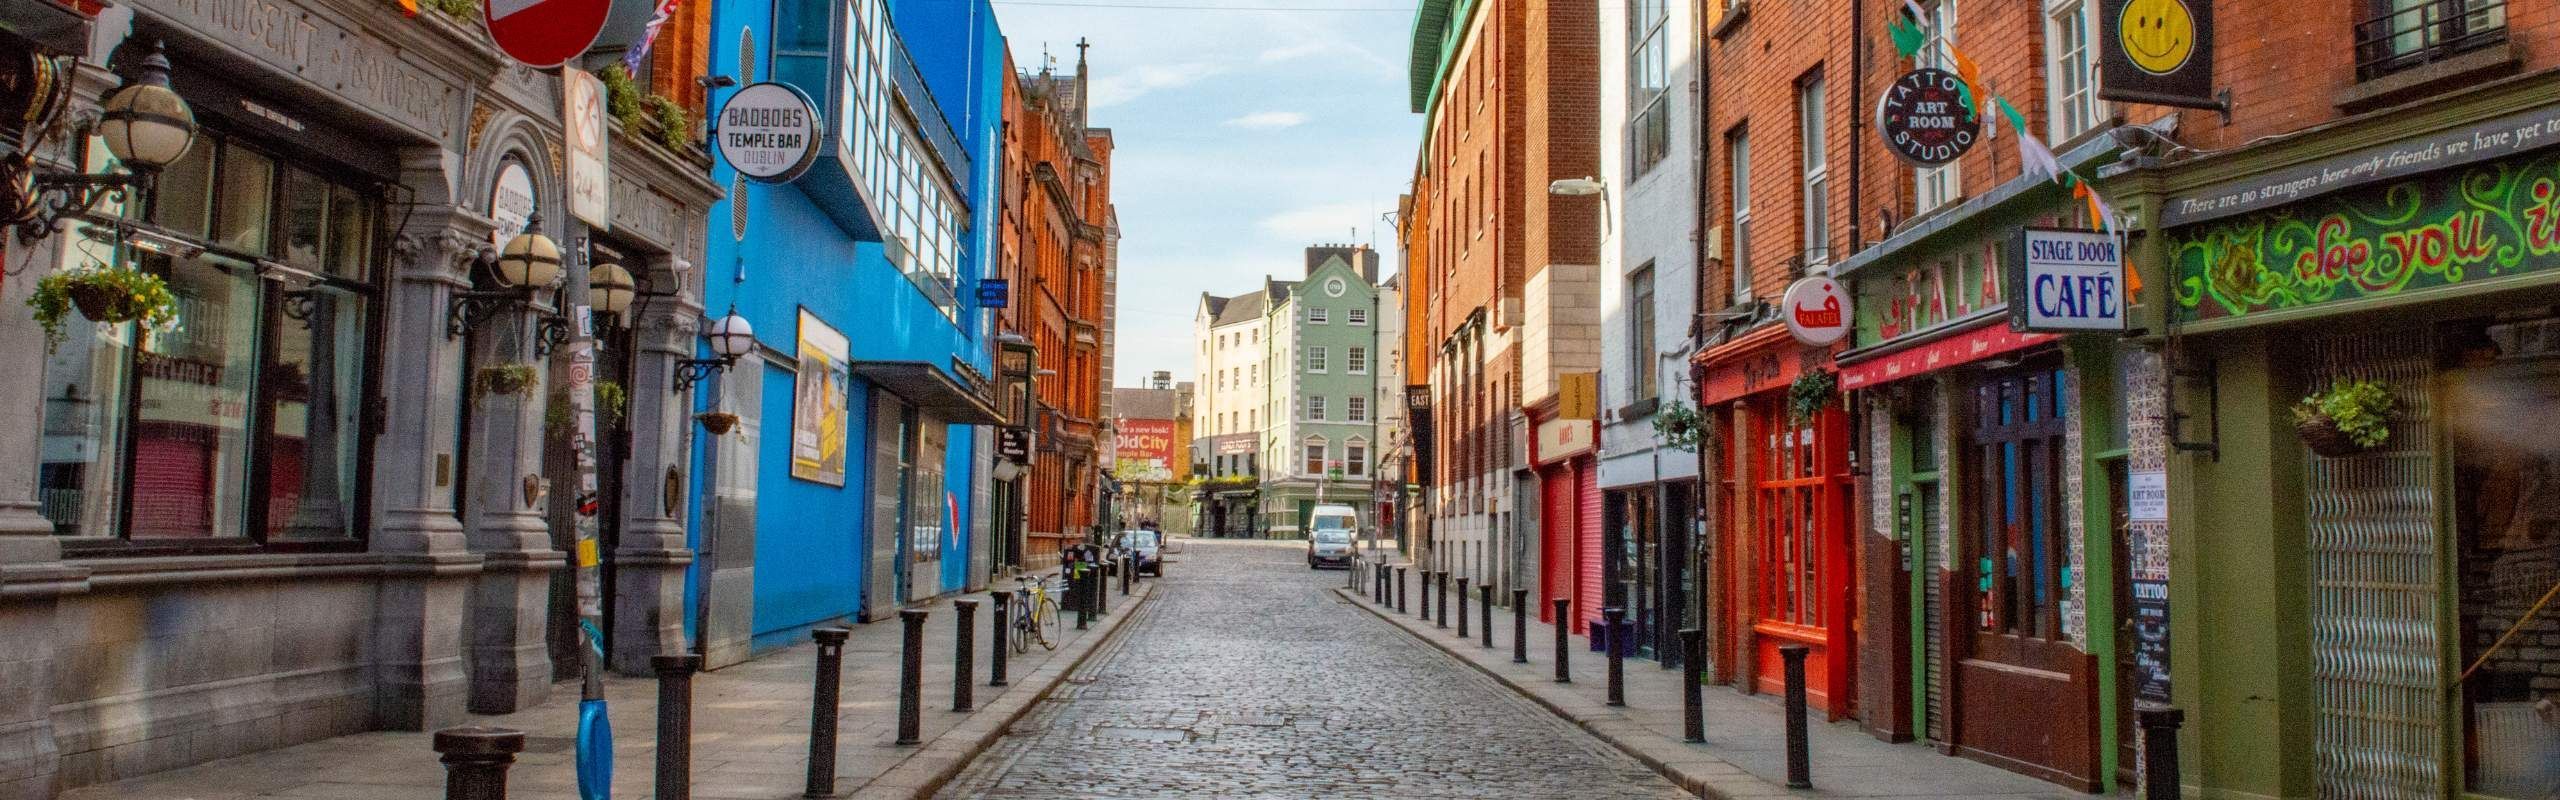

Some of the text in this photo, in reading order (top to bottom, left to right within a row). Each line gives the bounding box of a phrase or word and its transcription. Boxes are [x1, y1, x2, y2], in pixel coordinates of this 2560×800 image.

[212, 0, 320, 67] NUGENT
[729, 107, 802, 128] BADBOBS
[1915, 102, 1949, 114] ART
[1909, 116, 1955, 129] ROOM
[729, 133, 802, 148] TEMPLE BAR
[1895, 130, 1971, 160] STUDIO
[744, 150, 785, 164] DUBLIN
[2181, 198, 2215, 215] There
[2219, 194, 2238, 208] are
[2241, 190, 2257, 204] no
[2260, 174, 2317, 199] strangers
[2320, 168, 2349, 184] here
[2352, 156, 2385, 177] only
[2385, 143, 2441, 168] friends
[2446, 139, 2469, 156] we
[2473, 131, 2510, 151] have
[2513, 122, 2541, 149] yet
[2032, 240, 2116, 262] STAGE DOOR
[2362, 211, 2497, 293] you
[2034, 271, 2117, 318] CAFÉ
[1800, 312, 1838, 325] FALAFEL
[1411, 395, 1429, 406] EAST
[1115, 434, 1169, 453] OldCity
[2135, 583, 2169, 600] TATTOO
